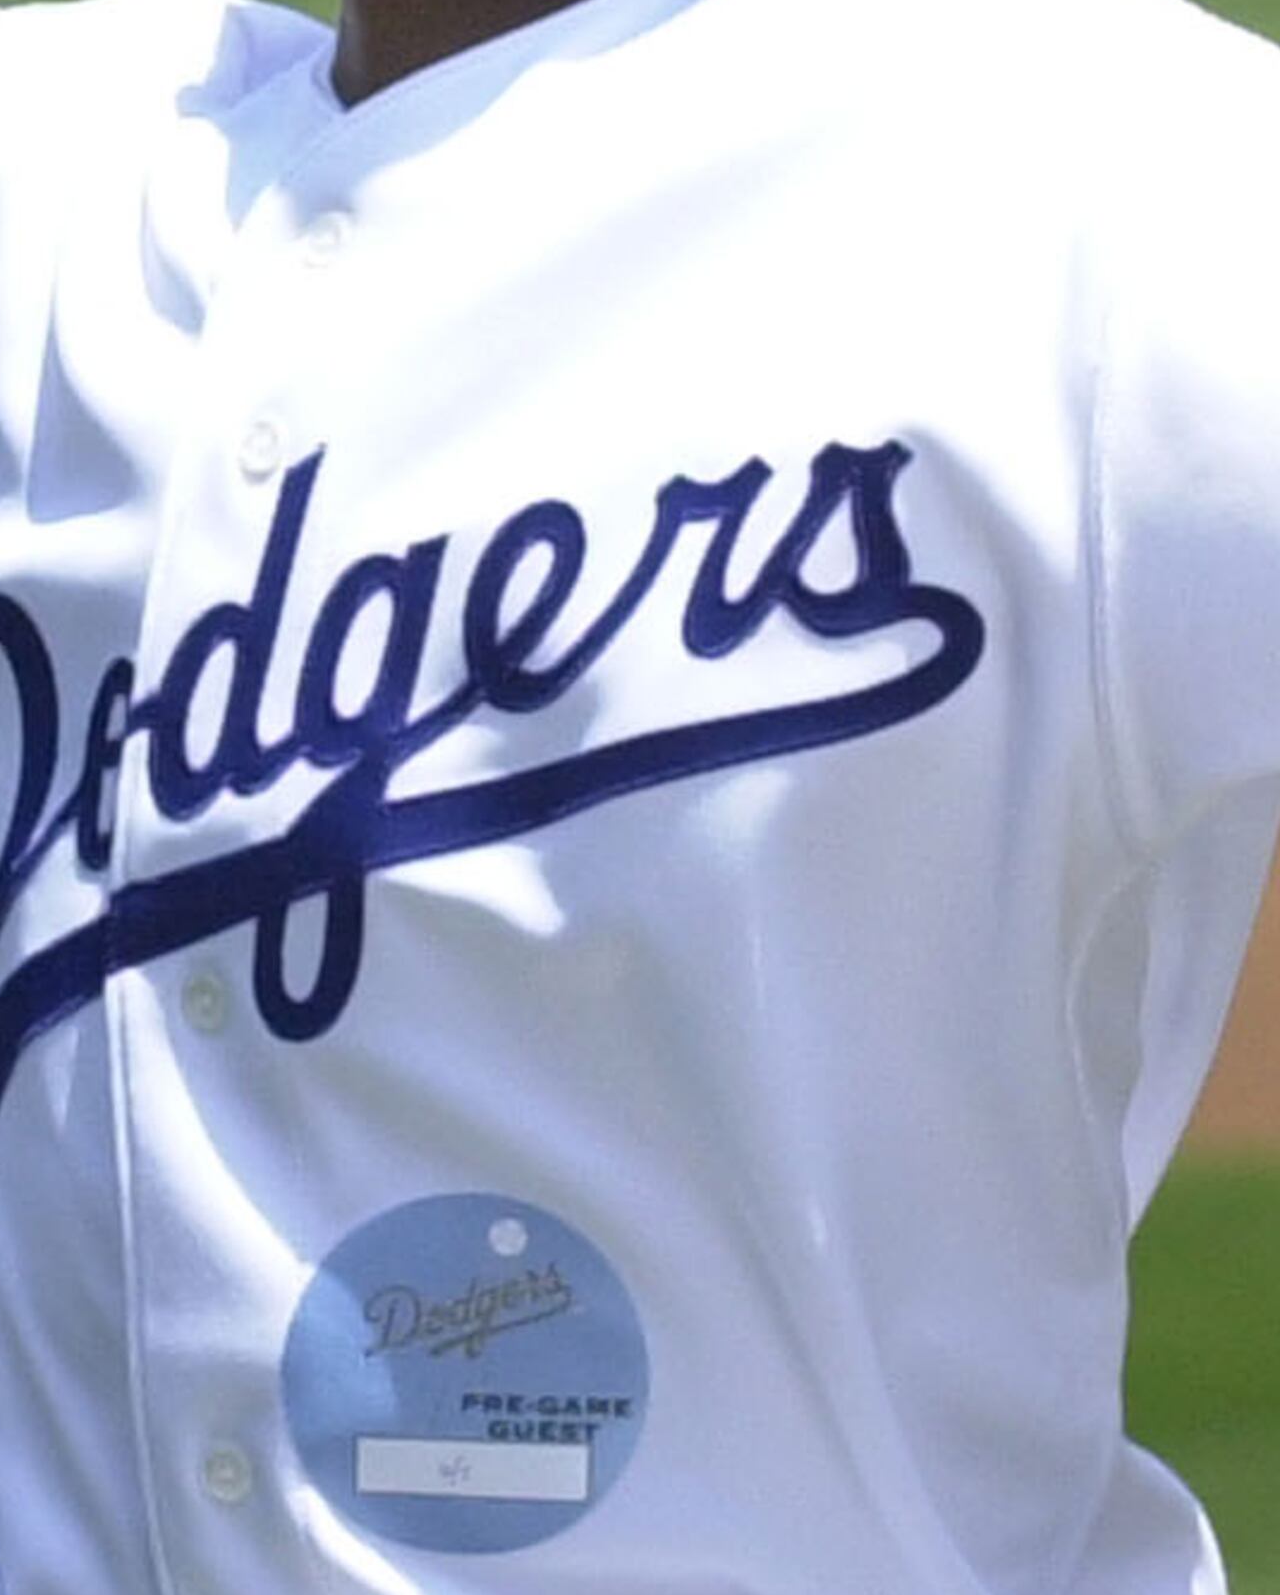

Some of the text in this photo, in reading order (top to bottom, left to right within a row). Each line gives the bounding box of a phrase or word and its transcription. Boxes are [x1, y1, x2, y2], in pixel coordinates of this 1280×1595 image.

[363, 1261, 575, 1360] Dodgers
[460, 1391, 634, 1420] PRE-GAME
[486, 1418, 602, 1443] GUEST
